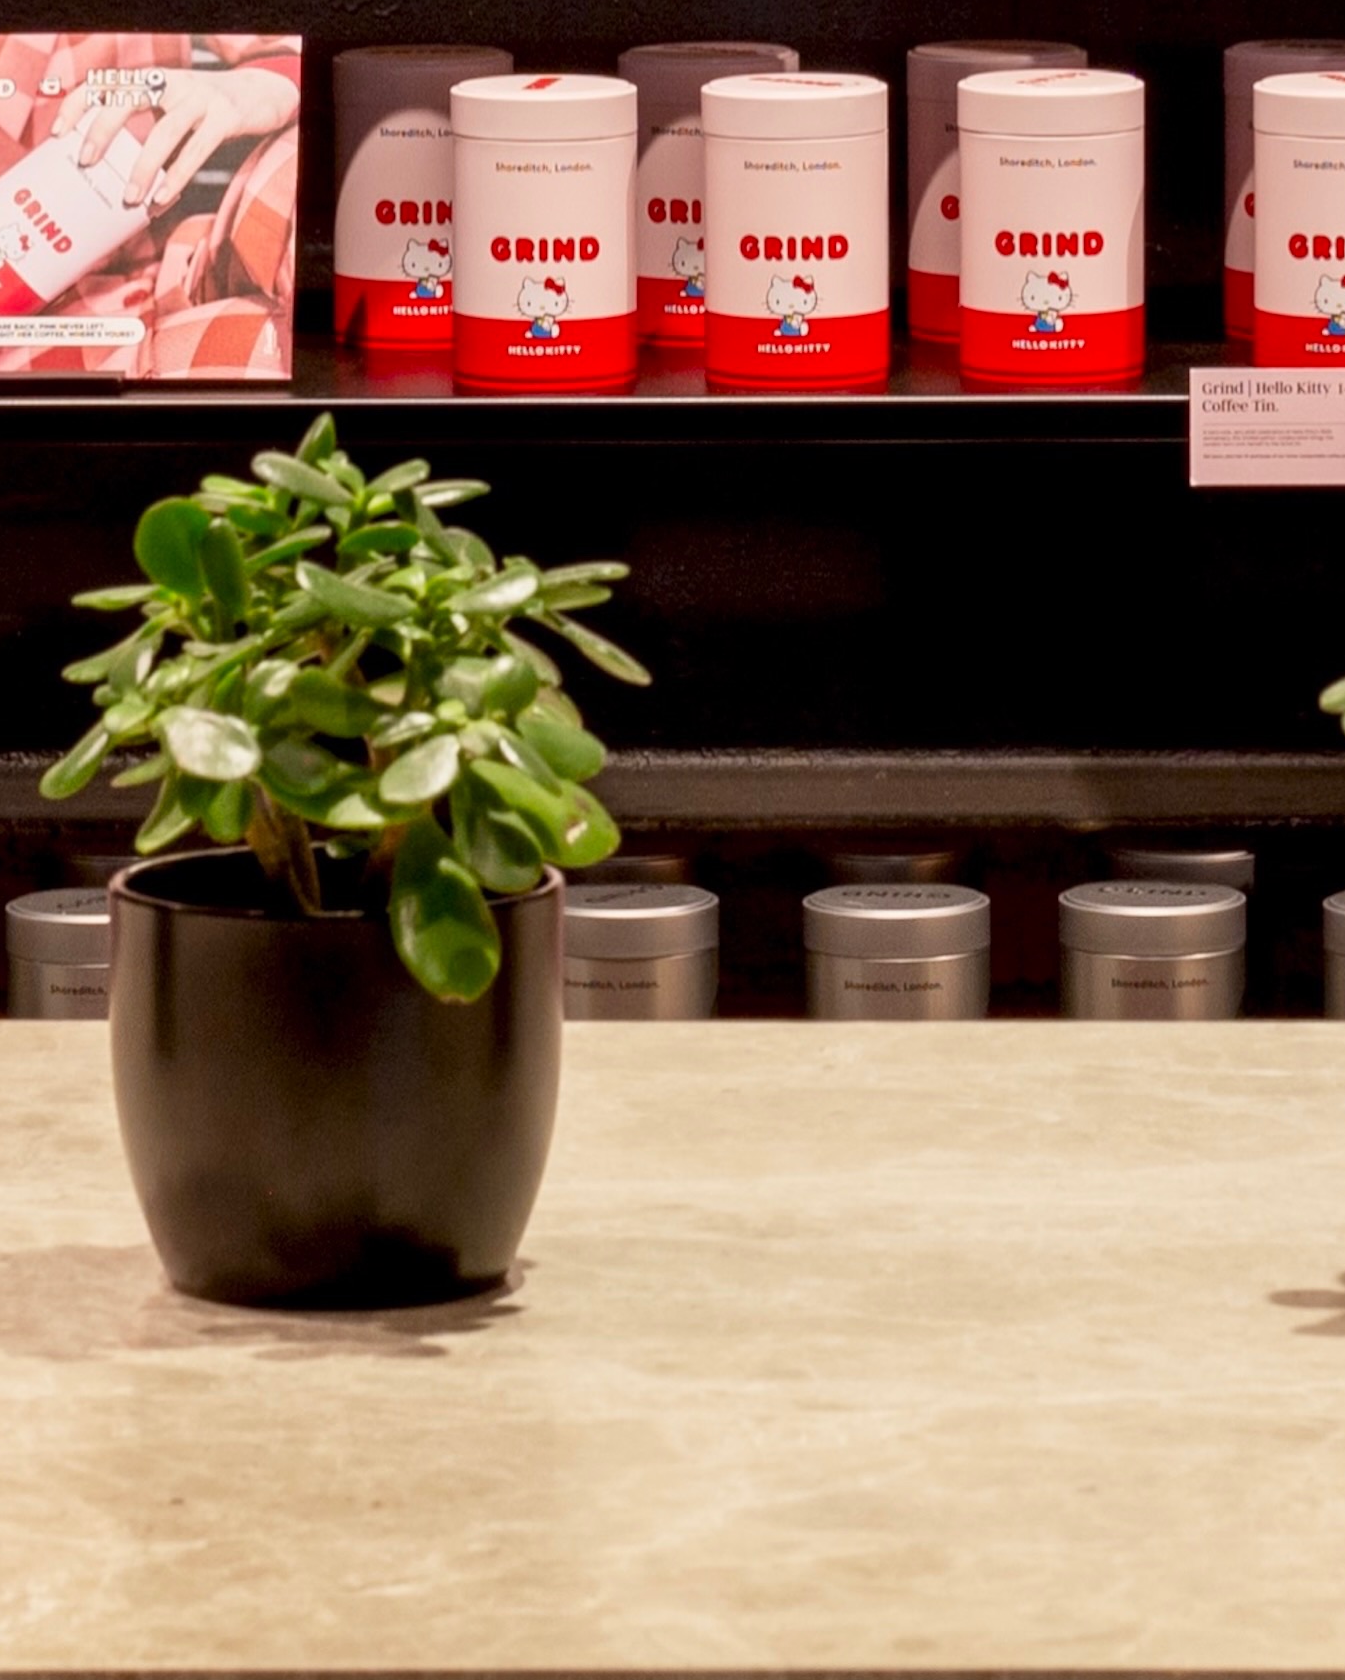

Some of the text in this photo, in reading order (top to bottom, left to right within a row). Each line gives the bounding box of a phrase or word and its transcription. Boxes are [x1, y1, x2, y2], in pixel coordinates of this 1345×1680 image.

[87, 68, 165, 87] HELLO
[86, 88, 164, 107] KITTY
[490, 236, 600, 263] GRIND
[739, 234, 849, 262] GRIND
[1201, 380, 1244, 395] Grind
[1255, 381, 1293, 395] Hello
[1296, 380, 1332, 400] Kitty
[1201, 398, 1279, 413] Coffee Tin.
